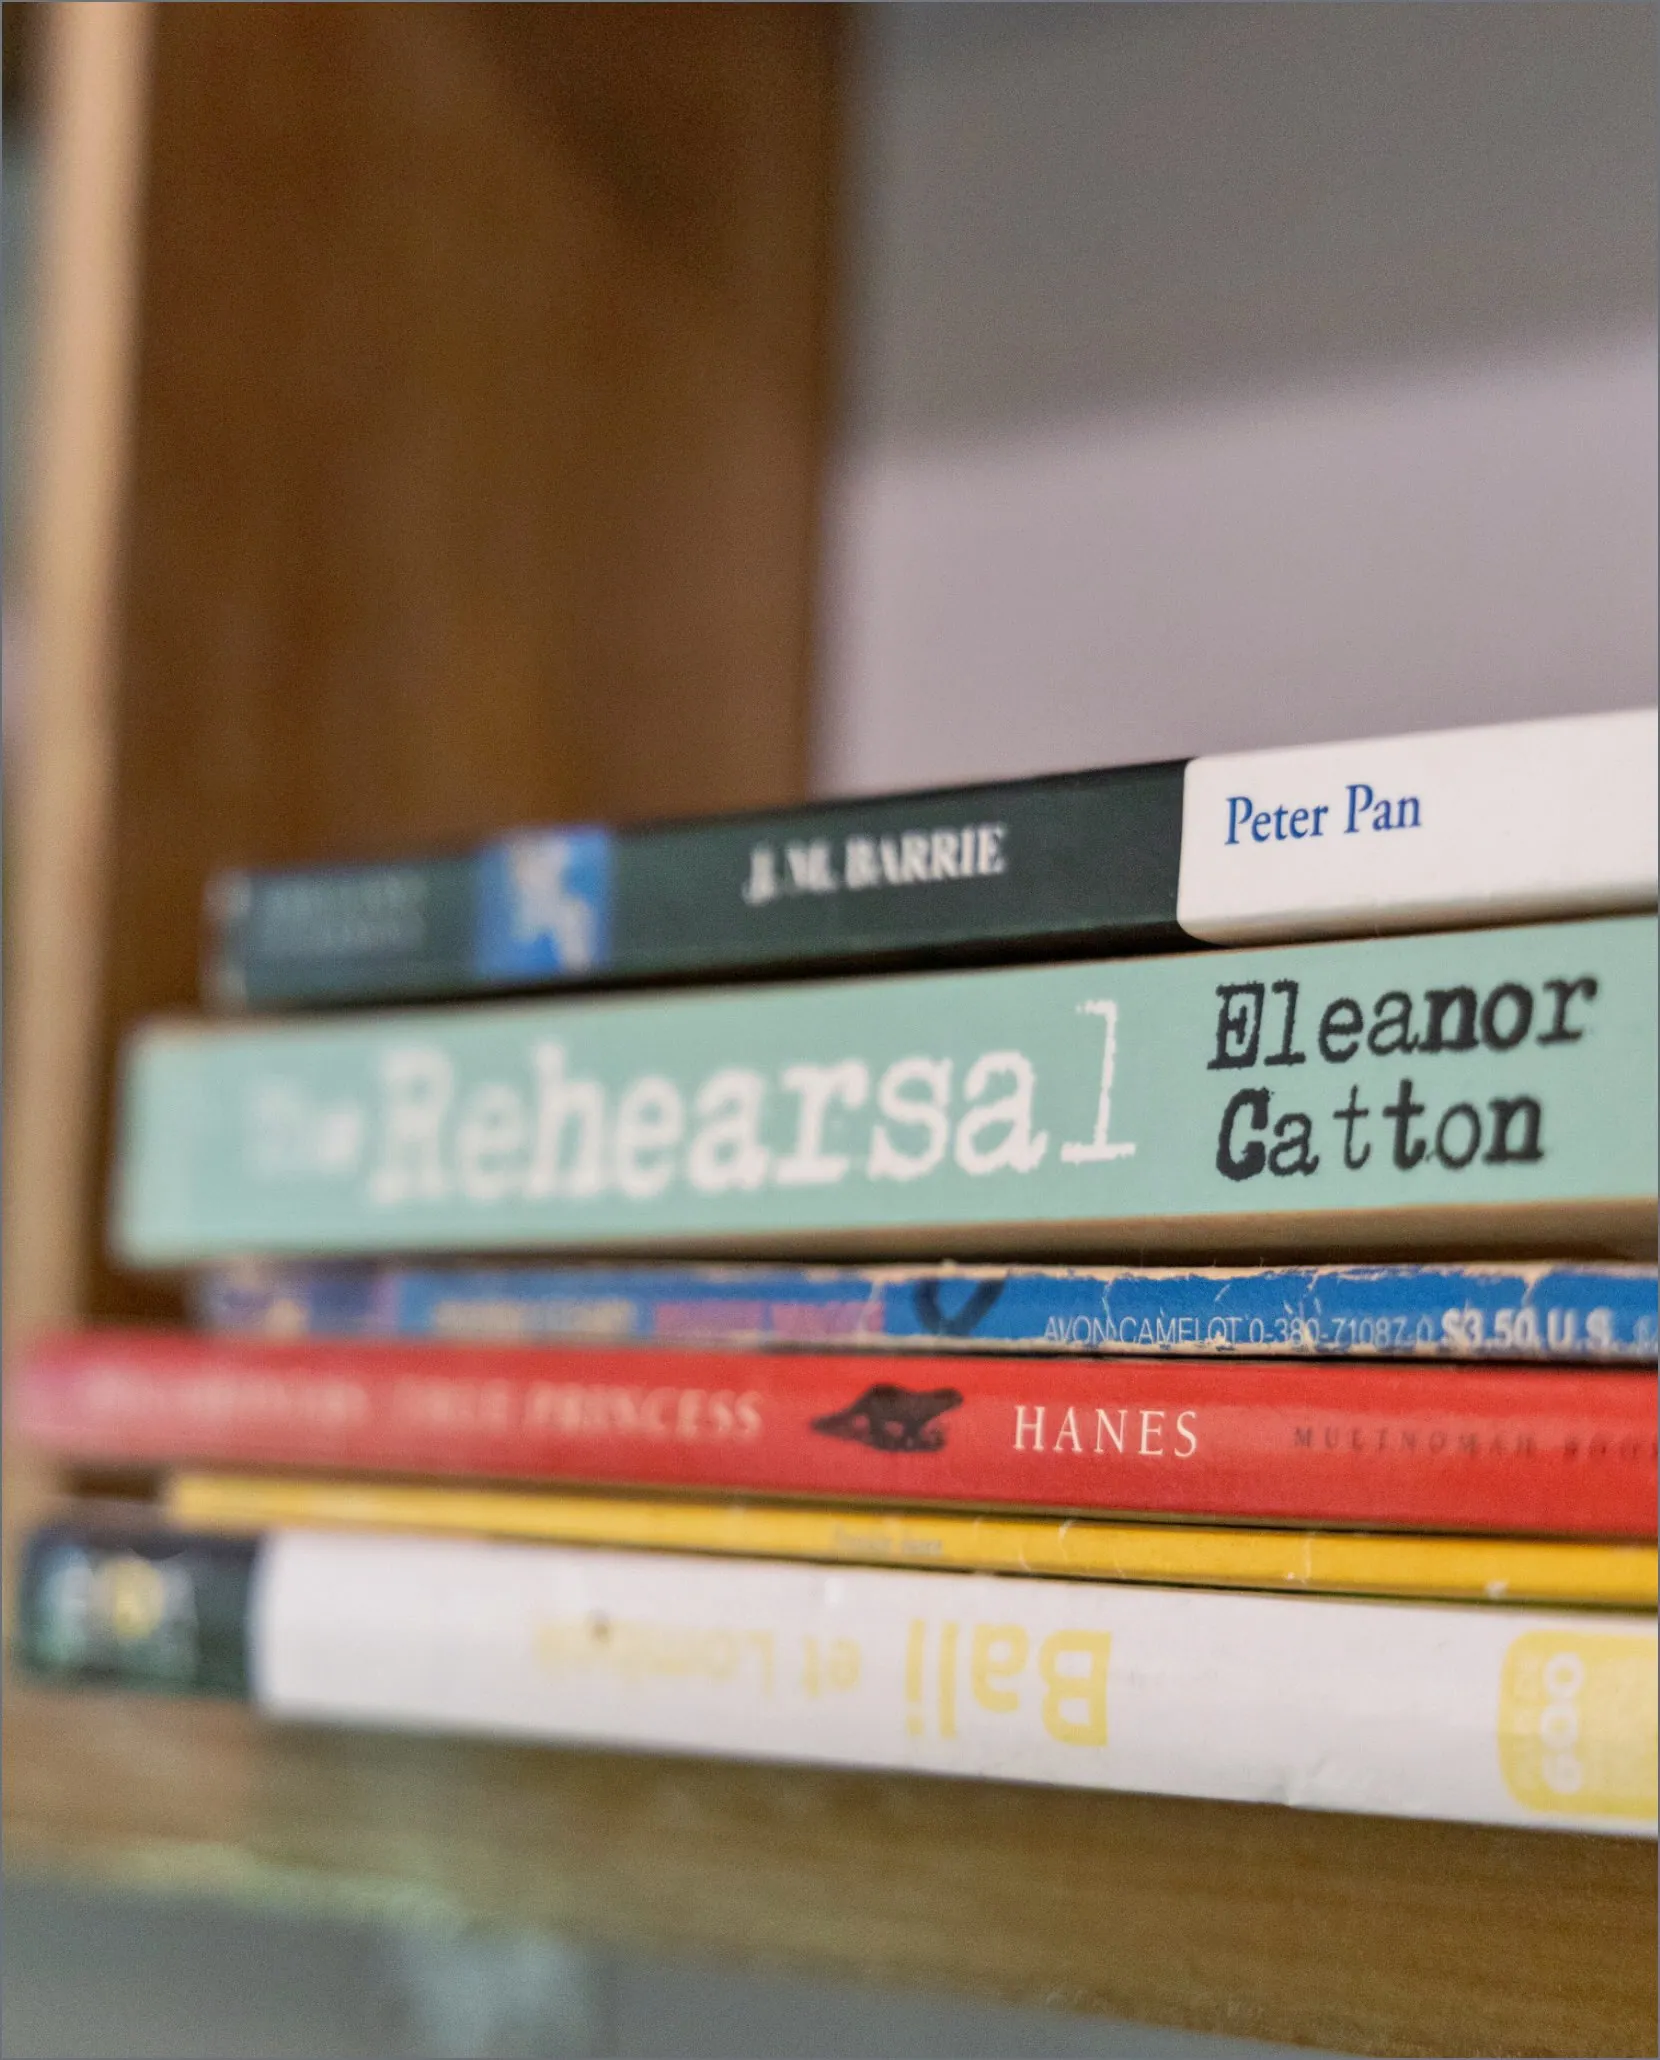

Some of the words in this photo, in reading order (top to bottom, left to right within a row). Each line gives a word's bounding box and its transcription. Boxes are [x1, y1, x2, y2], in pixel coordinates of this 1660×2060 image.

[1224, 796, 1329, 846] Peter
[1344, 783, 1422, 835] Pan
[845, 822, 1008, 890] BARRIE
[1206, 975, 1598, 1071] Eleanor
[368, 999, 1136, 1206] Rehearsal
[1215, 1078, 1545, 1181] Catton
[1043, 1315, 1114, 1345] AVON
[1118, 1316, 1243, 1346] CAMELOT
[1012, 1405, 1198, 1458] HANES
[904, 1619, 1113, 1747] Bali
